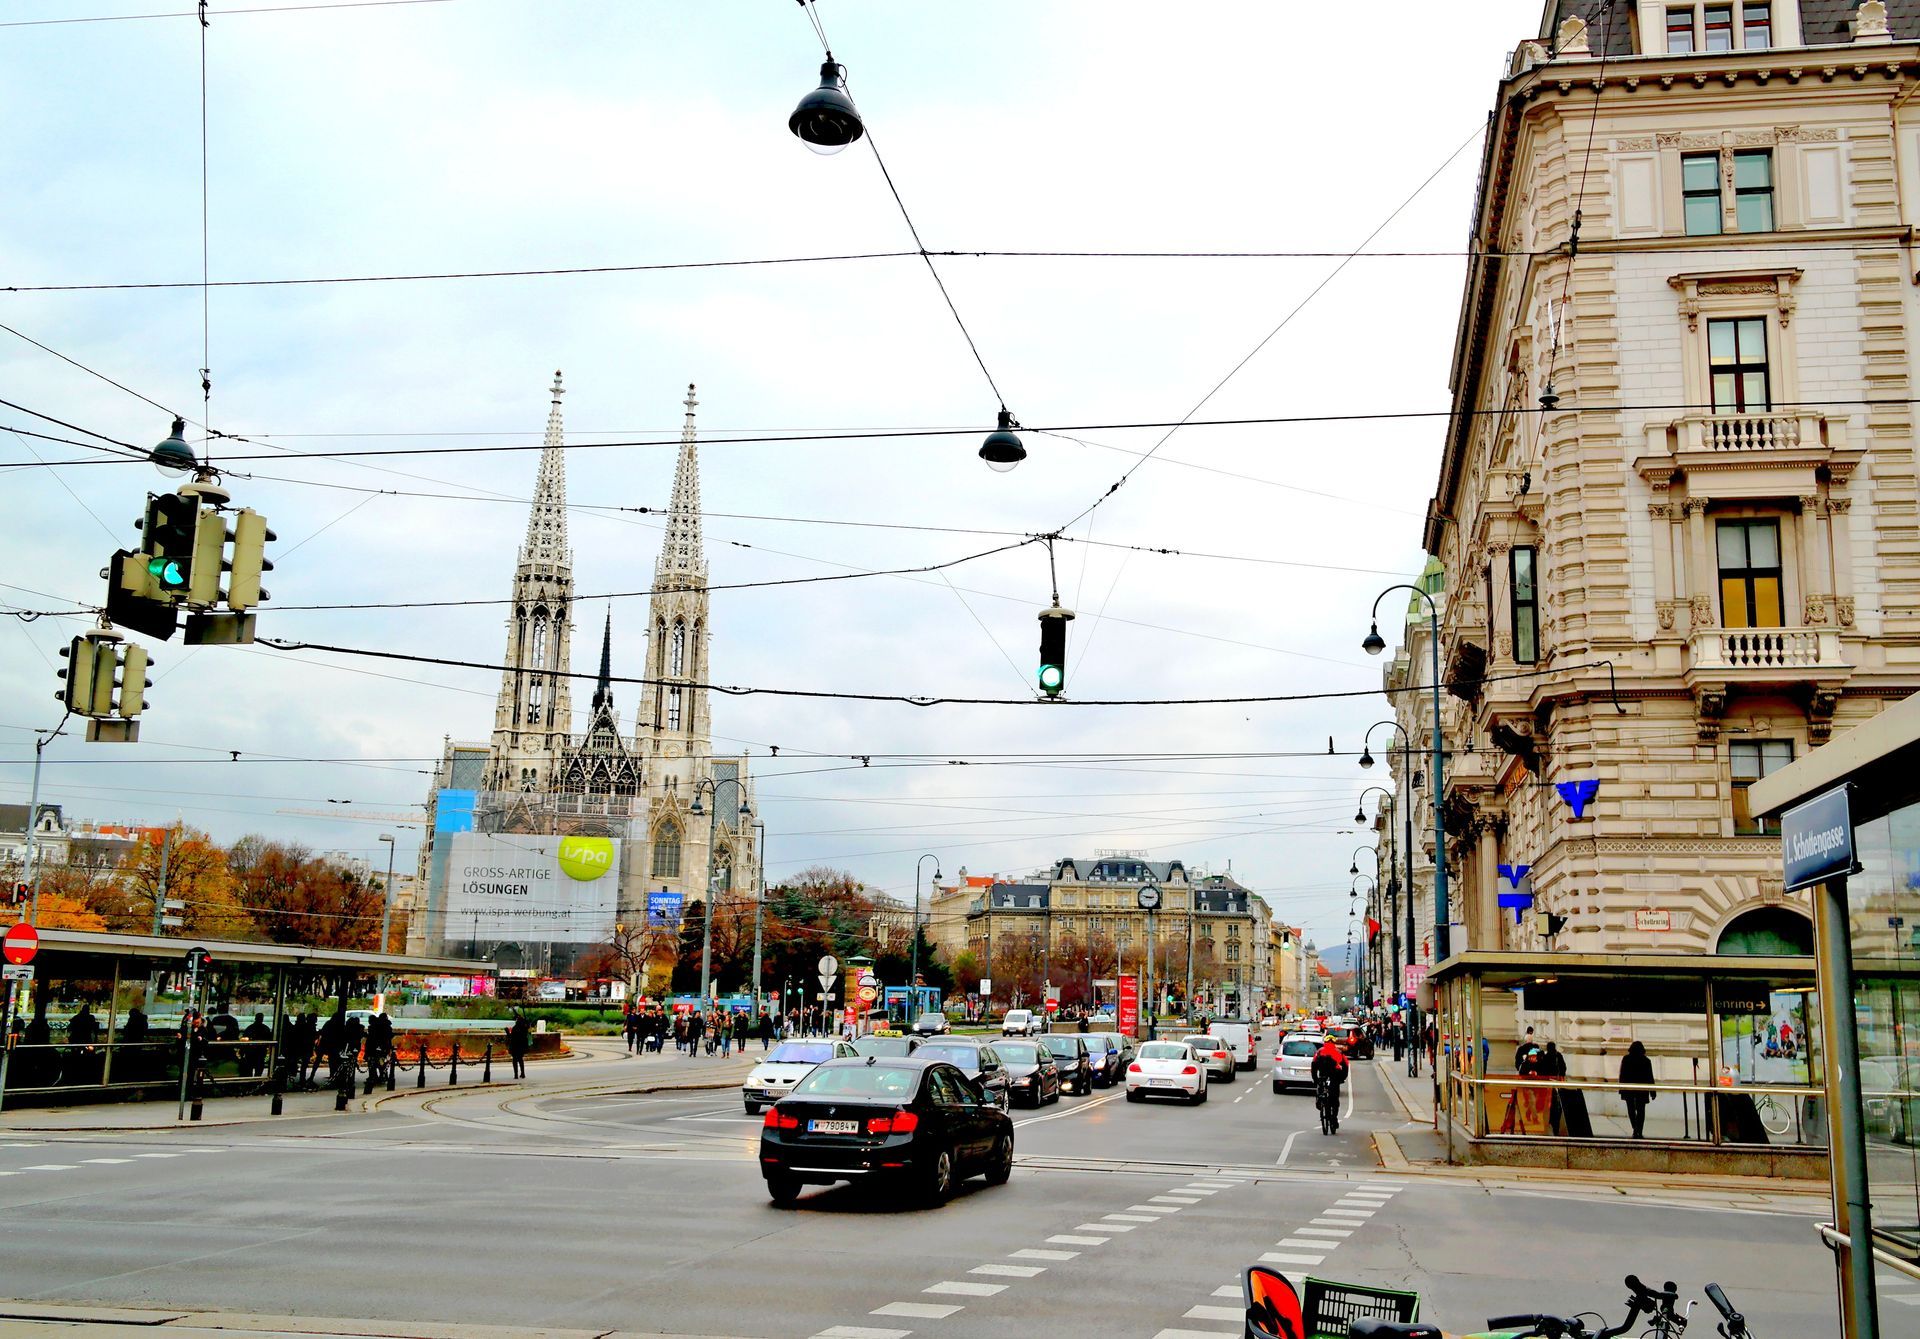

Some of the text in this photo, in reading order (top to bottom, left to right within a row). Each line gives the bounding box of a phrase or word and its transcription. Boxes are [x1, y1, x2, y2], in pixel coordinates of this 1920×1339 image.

[1793, 825, 1844, 859] Schottengasse
[463, 866, 551, 880] GROSS-ARTIGE
[462, 880, 528, 895] LÖSUNGEN
[650, 896, 681, 905] SONNTAG
[460, 905, 571, 920] www.ispa-werbung.at
